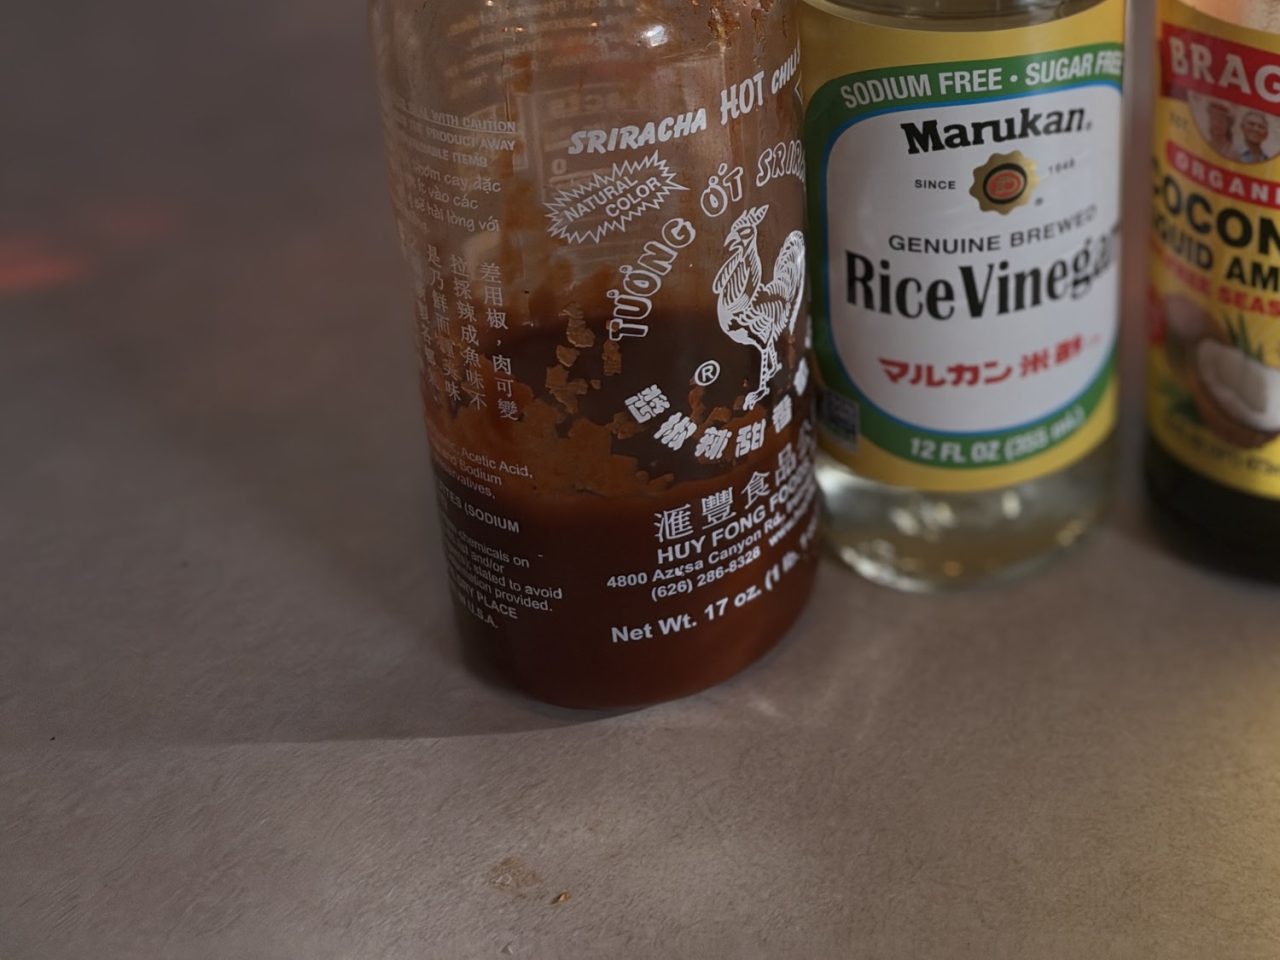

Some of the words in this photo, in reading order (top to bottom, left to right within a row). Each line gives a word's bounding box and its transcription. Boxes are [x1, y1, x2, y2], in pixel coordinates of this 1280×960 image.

[840, 73, 932, 108] SODIUM
[938, 67, 1003, 96] FREE
[1024, 57, 1094, 87] SUGAR
[462, 117, 516, 132] CAUTION
[568, 108, 707, 156] SRIRACHA
[720, 70, 764, 126] HOT
[426, 127, 478, 147] PRODUCT
[479, 138, 517, 151] AWAY
[900, 107, 1086, 155] Marukan
[444, 174, 468, 191] cay
[472, 173, 502, 194] đặc
[605, 176, 661, 217] COLOR
[914, 178, 956, 190] SINCE
[453, 194, 479, 210] các
[564, 176, 639, 222] NATURAL
[888, 234, 1003, 254] GENUINE
[1009, 203, 1098, 249] BREWED
[844, 249, 955, 321] Rice
[460, 447, 497, 469] Acetic
[910, 437, 936, 461] 12
[940, 441, 967, 464] FL
[971, 440, 1000, 463] OZ
[459, 460, 502, 485] Sodium
[464, 502, 520, 533] (SODIUM
[657, 536, 706, 564] HUY
[712, 505, 766, 548] FONG
[513, 556, 530, 569] on
[606, 572, 648, 588] 4800
[708, 530, 762, 564] Canyon
[651, 578, 693, 602] (626)
[697, 545, 761, 587] 286-8328
[494, 588, 553, 612] provided.
[509, 578, 521, 592] to
[525, 585, 563, 600] avoid
[476, 591, 518, 619] PLACE
[611, 623, 653, 643] Net
[658, 612, 697, 637] Wt.
[704, 597, 729, 621] 17
[734, 585, 763, 608] oz.
